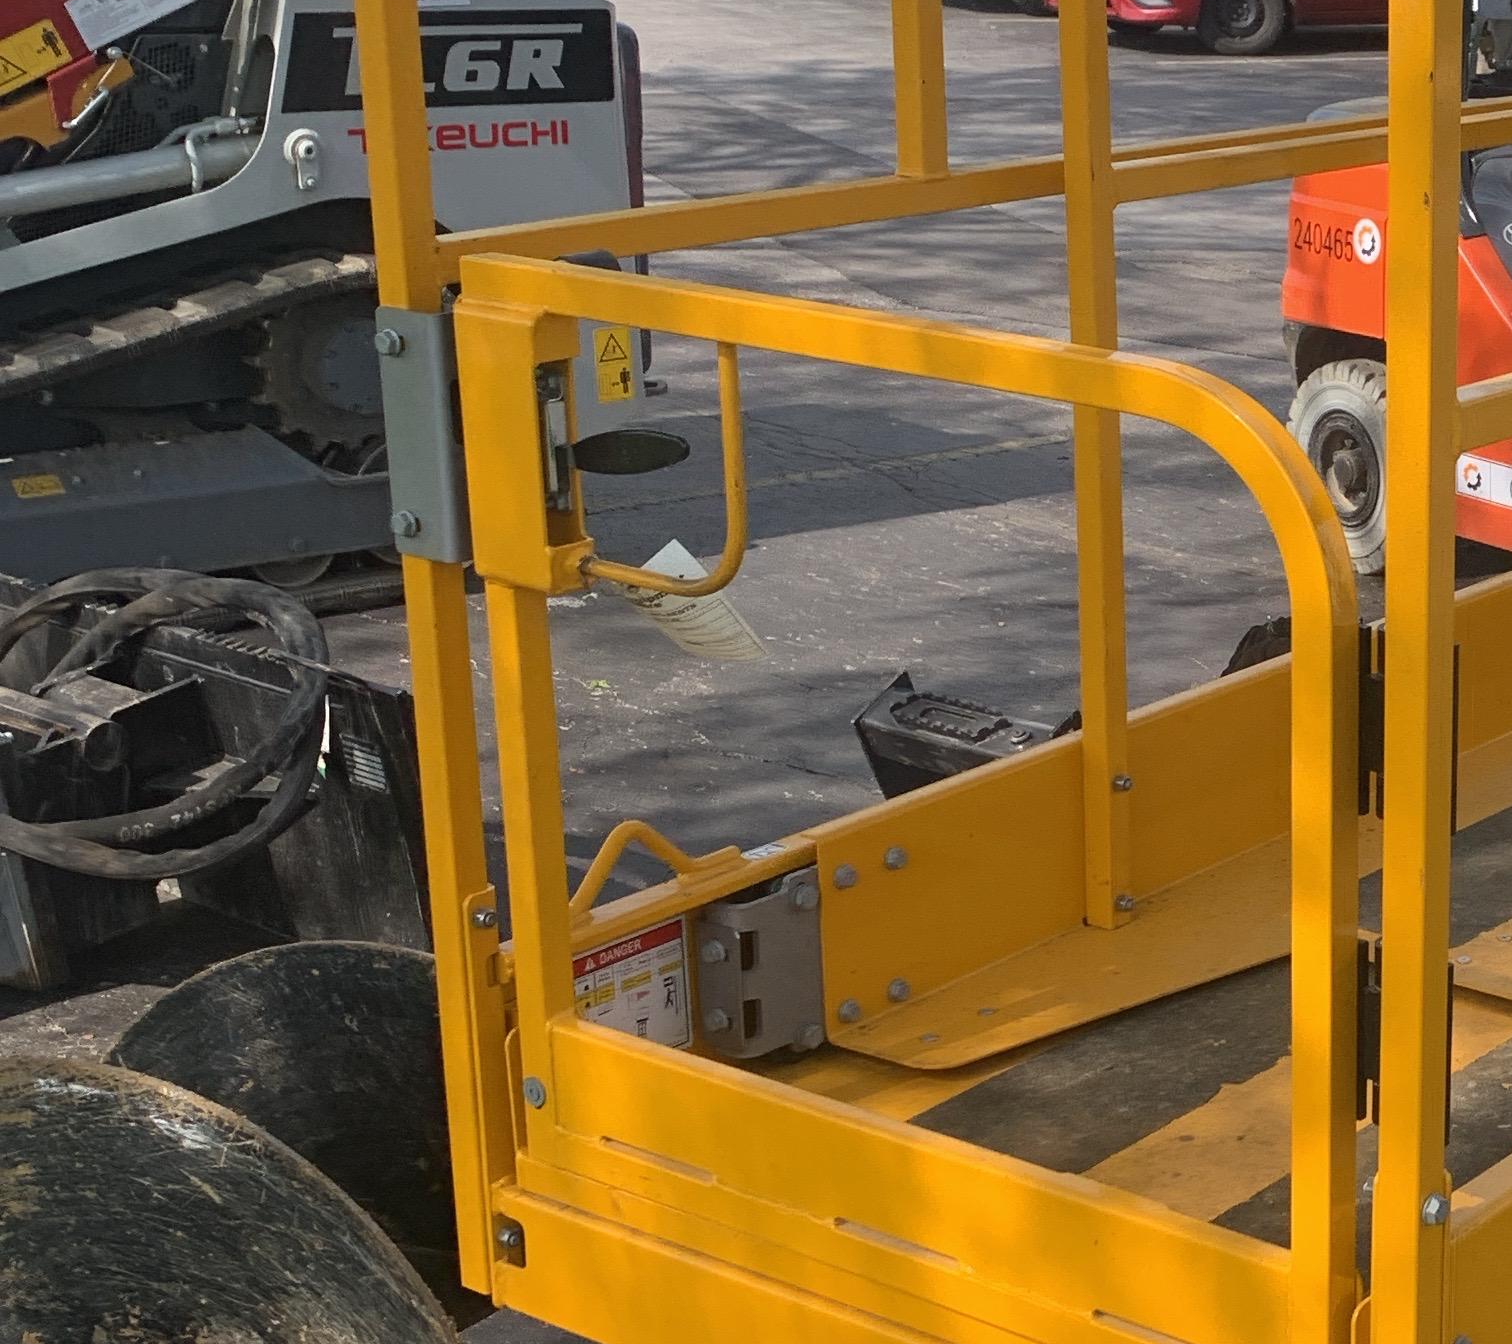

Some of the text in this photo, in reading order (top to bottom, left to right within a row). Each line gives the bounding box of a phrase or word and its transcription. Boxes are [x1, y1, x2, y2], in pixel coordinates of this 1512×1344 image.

[347, 119, 569, 155] TEUCHI
[1294, 217, 1354, 263] 240465
[600, 938, 642, 964] DANGER
